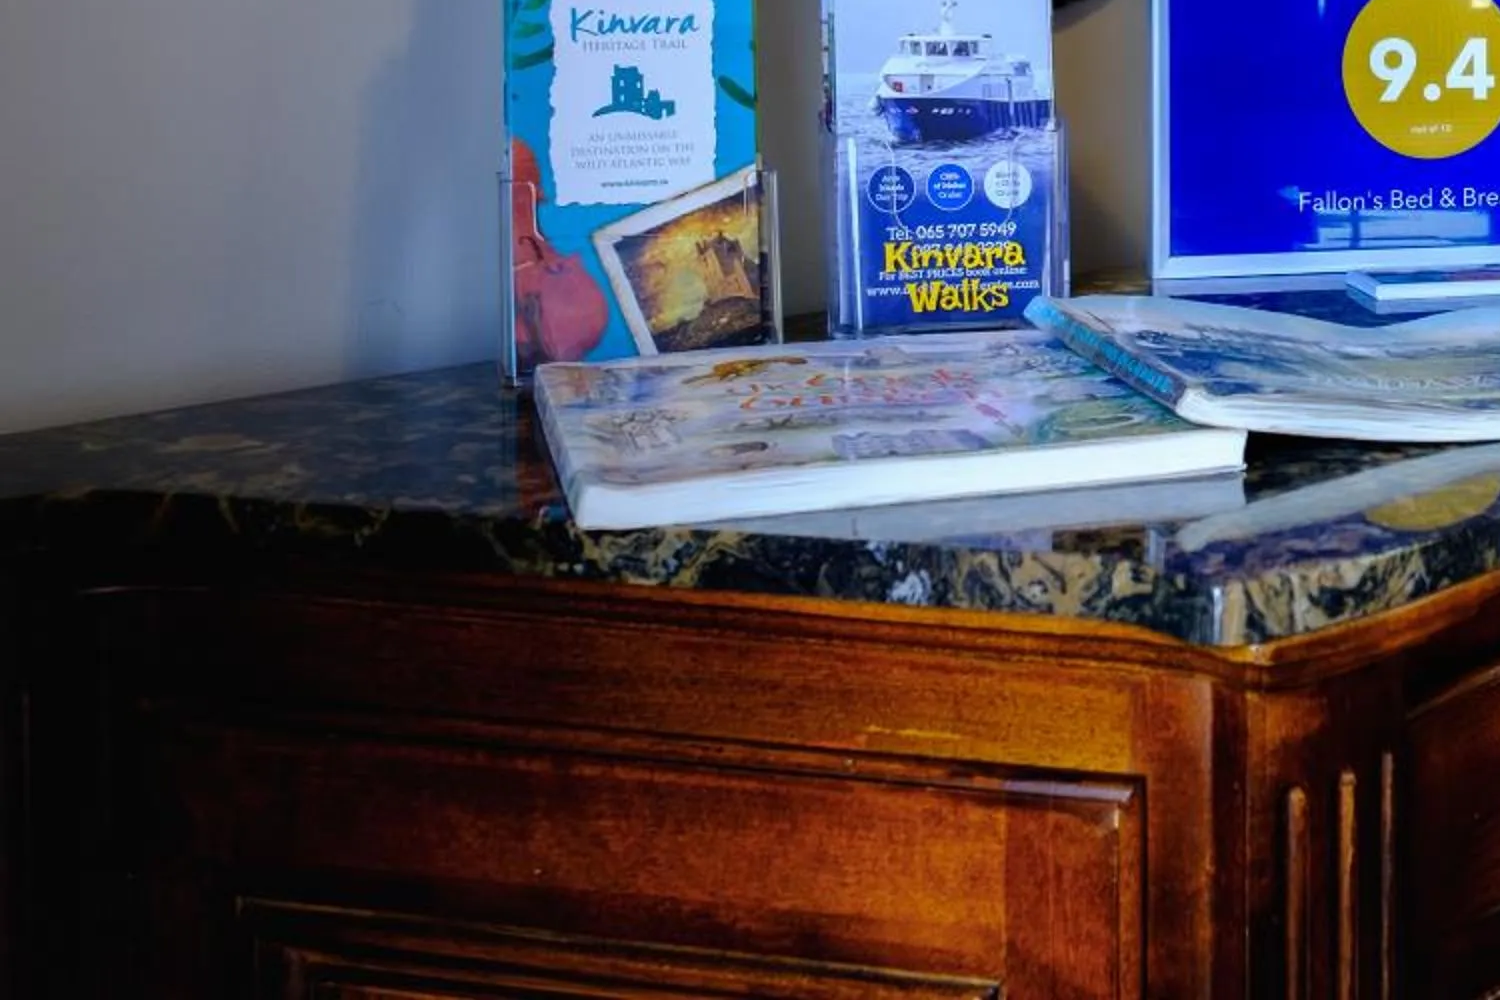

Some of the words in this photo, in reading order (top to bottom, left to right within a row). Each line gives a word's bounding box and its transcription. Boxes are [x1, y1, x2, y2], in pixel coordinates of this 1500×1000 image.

[570, 7, 700, 42] Kinvara
[583, 40, 647, 52] HERITAGE
[652, 39, 688, 49] TRAIL
[1369, 37, 1495, 102] 9.4
[1298, 190, 1383, 213] Fallon's
[1390, 188, 1433, 209] Bed
[1439, 187, 1456, 208] &
[916, 225, 945, 240] 065
[947, 224, 977, 239] 707
[979, 222, 1018, 238] 5949
[905, 278, 1009, 313] Walks
